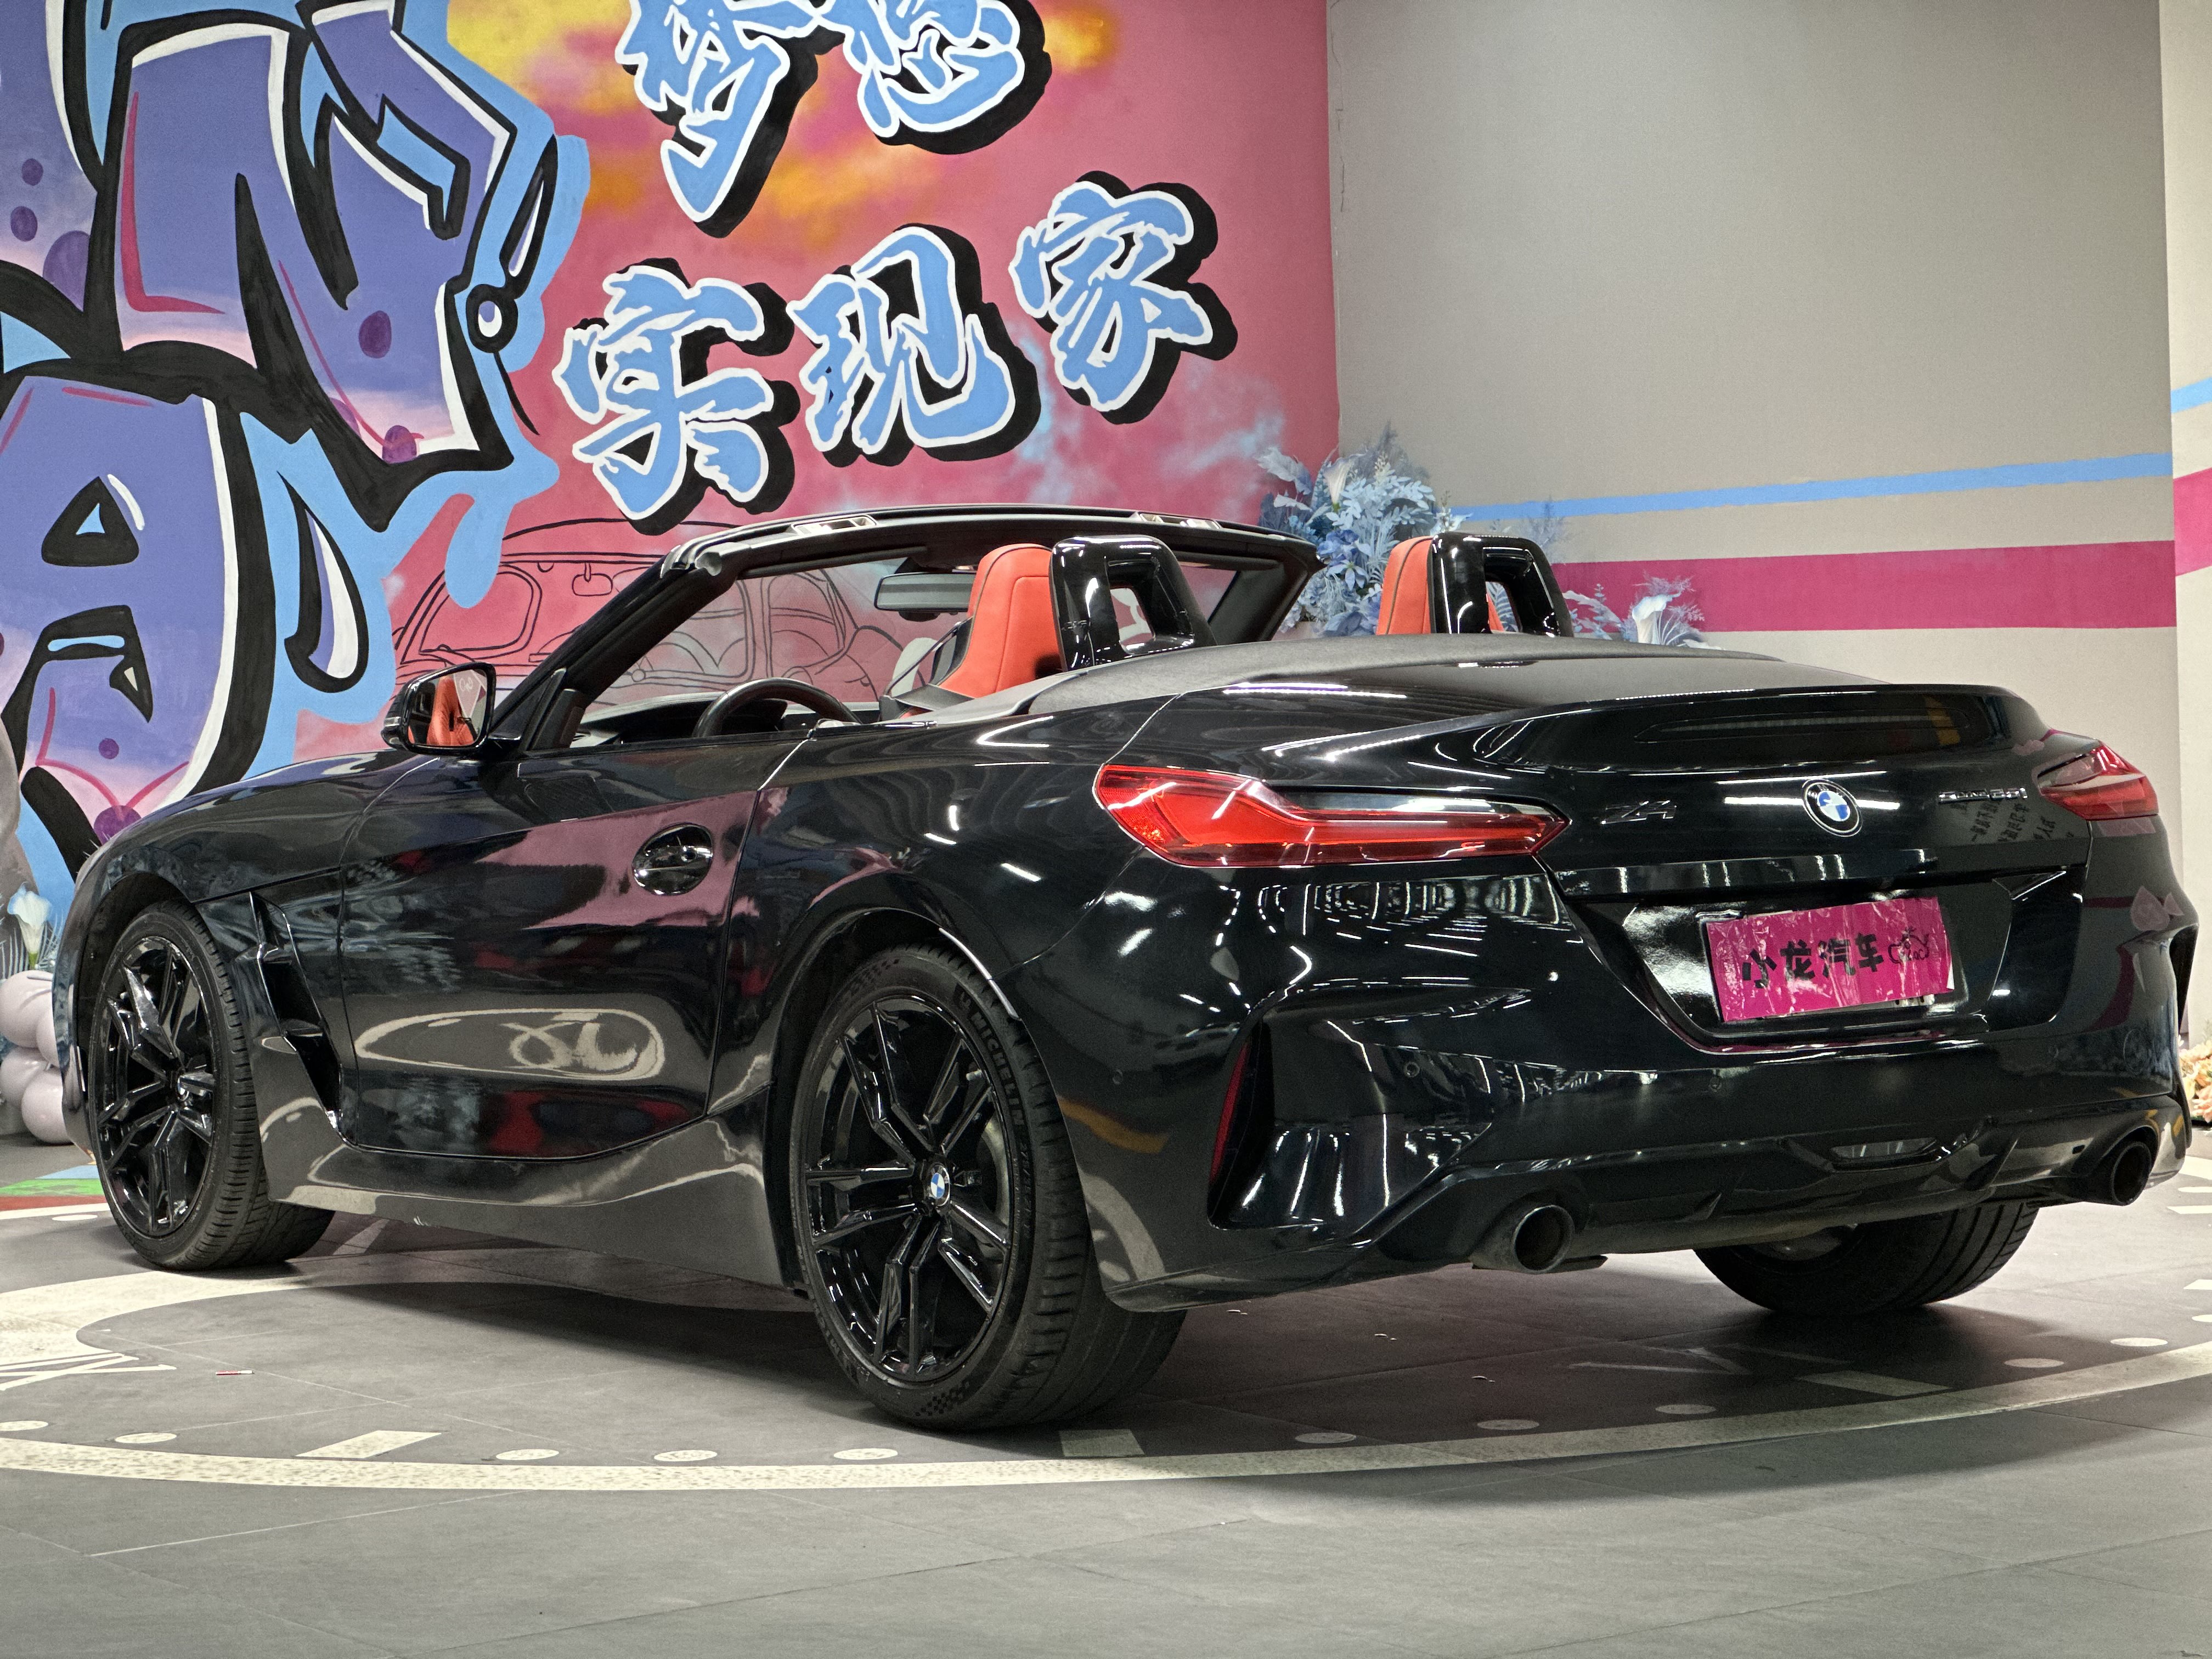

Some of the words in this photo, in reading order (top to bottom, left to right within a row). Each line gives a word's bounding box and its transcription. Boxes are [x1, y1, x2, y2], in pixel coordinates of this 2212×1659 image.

[553, 171, 1237, 534] 实现家
[1741, 932, 1884, 988] 小龙汽车
[970, 1011, 1024, 1126] MICHELIN
